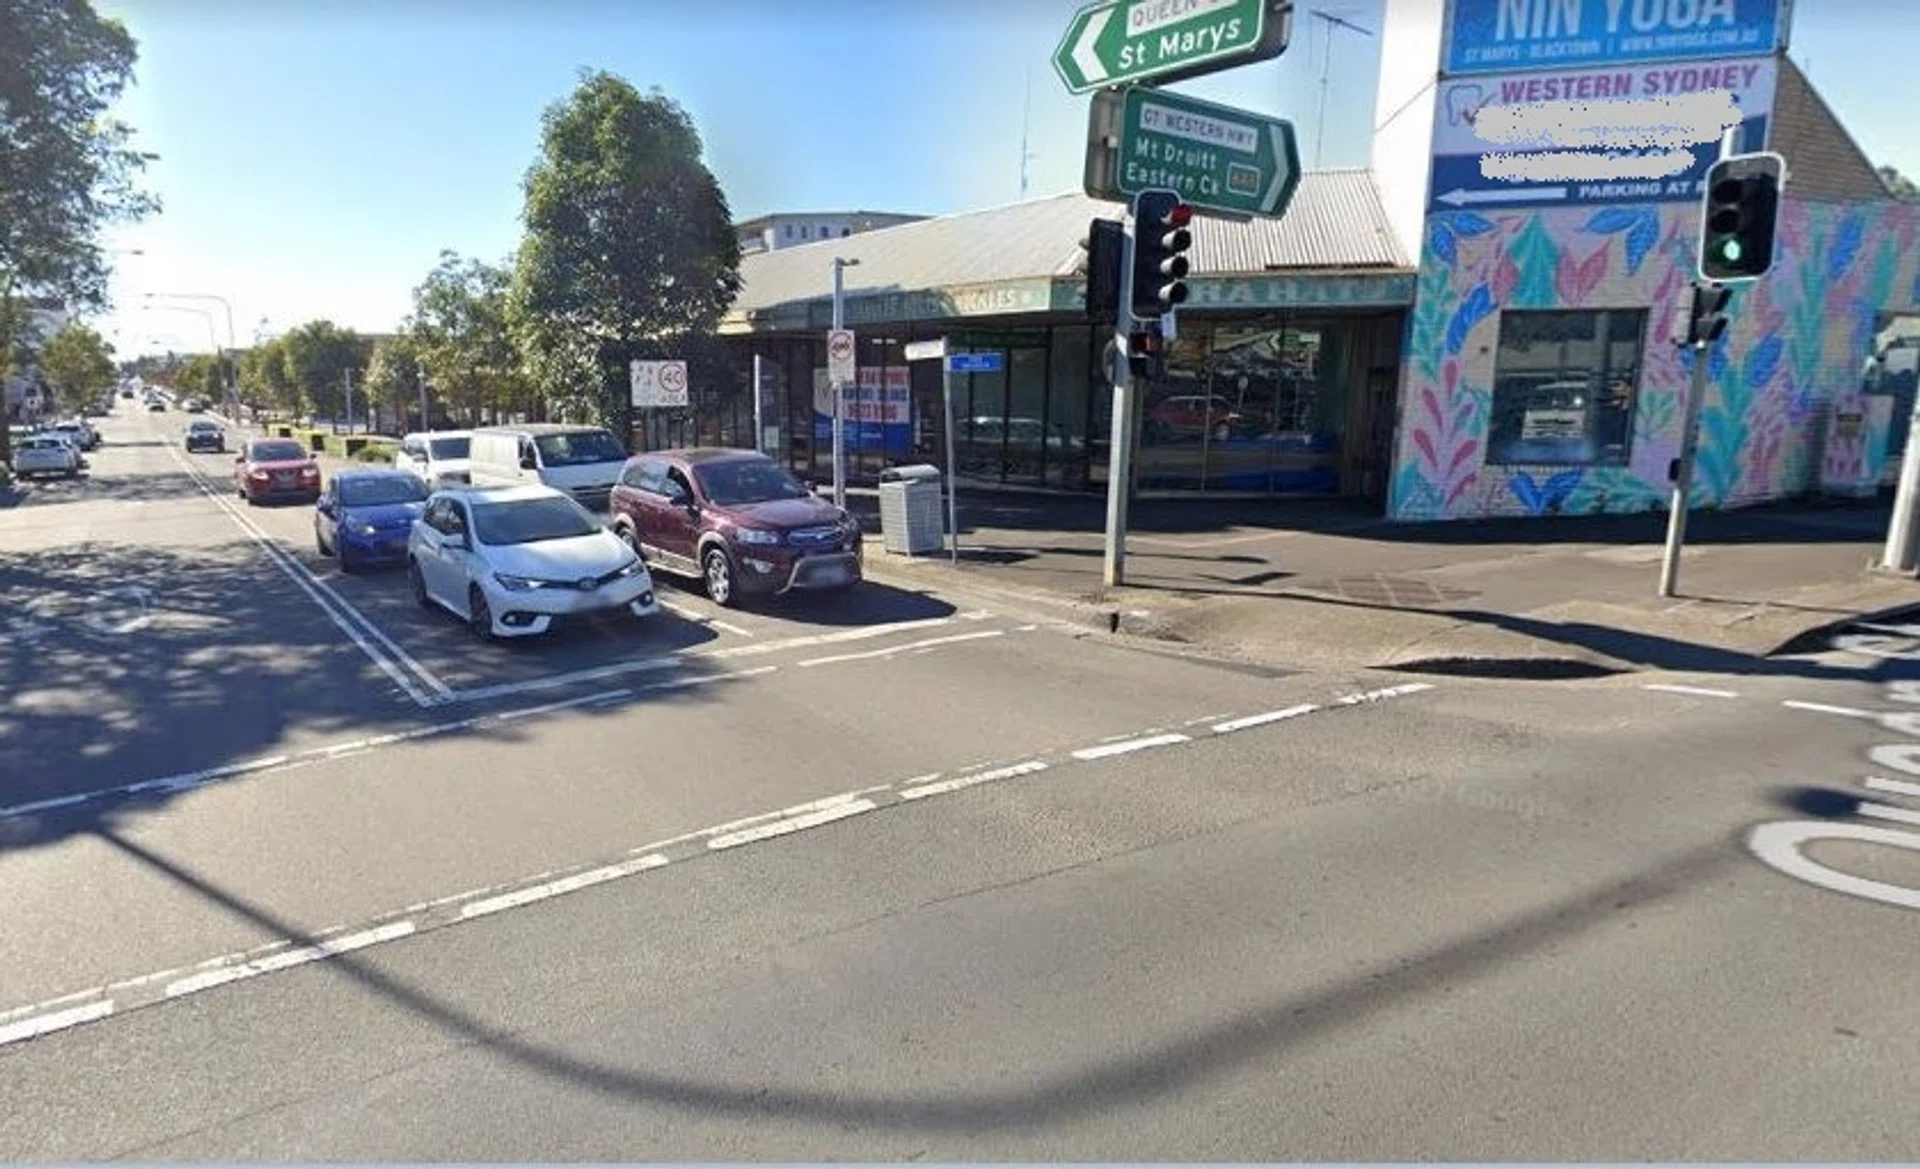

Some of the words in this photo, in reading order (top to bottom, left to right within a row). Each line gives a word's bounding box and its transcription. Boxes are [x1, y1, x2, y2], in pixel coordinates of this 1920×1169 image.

[1495, 0, 1583, 41] NIN
[1118, 41, 1146, 70] St
[1158, 18, 1242, 59] Marys
[1501, 72, 1633, 104] WESTERN
[1642, 63, 1760, 96] SYDNEY
[1166, 113, 1224, 139] WESTERN
[1135, 136, 1158, 160] Mt
[1164, 142, 1217, 171] Druitt
[1126, 161, 1195, 191] Eastern
[1578, 182, 1662, 199] PARKING
[1666, 180, 1691, 194] AT
